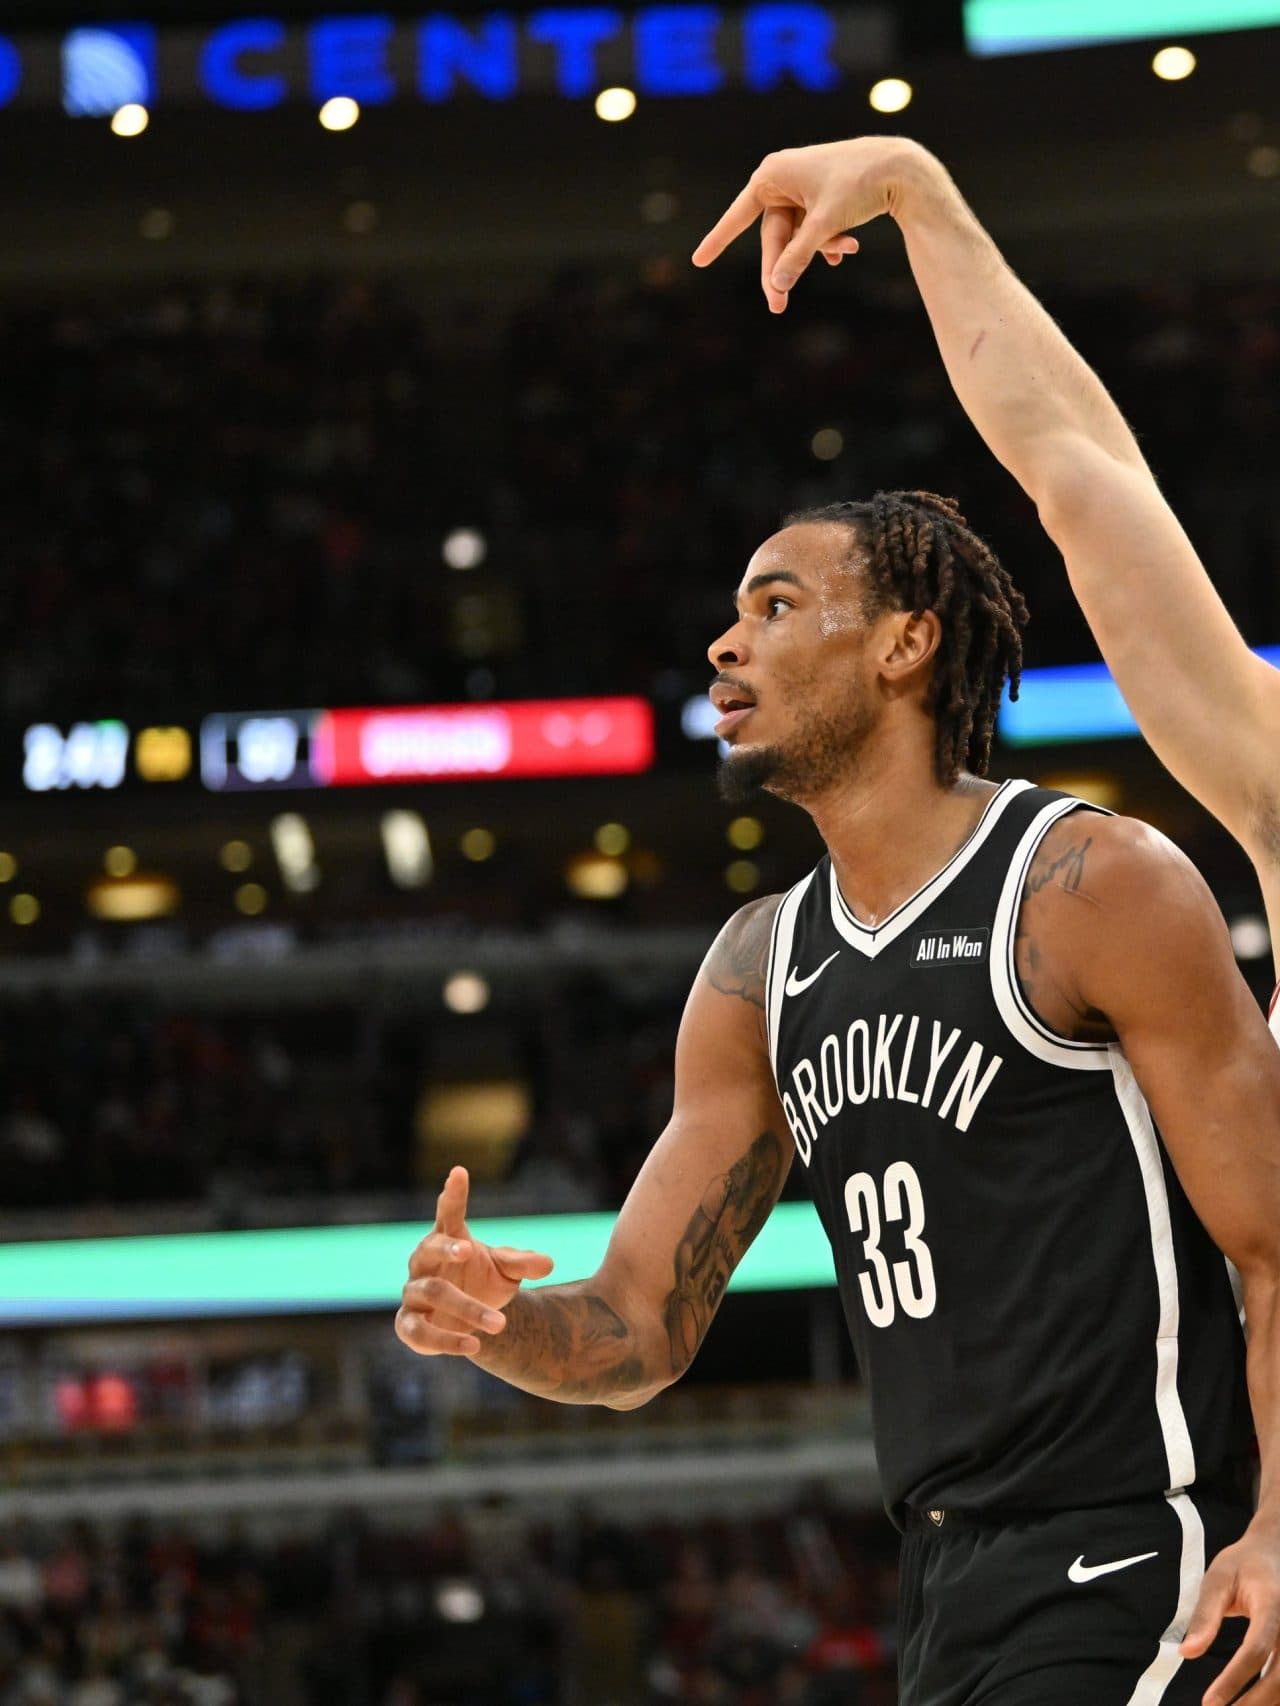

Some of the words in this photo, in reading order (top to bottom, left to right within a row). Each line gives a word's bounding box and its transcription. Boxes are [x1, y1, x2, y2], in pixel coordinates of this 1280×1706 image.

[198, 2, 841, 112] CENTER
[916, 937, 936, 961] All
[937, 936, 951, 959] In
[952, 935, 983, 958] Won
[783, 1014, 1004, 1168] BROOKLYN
[844, 1160, 937, 1329] 33
